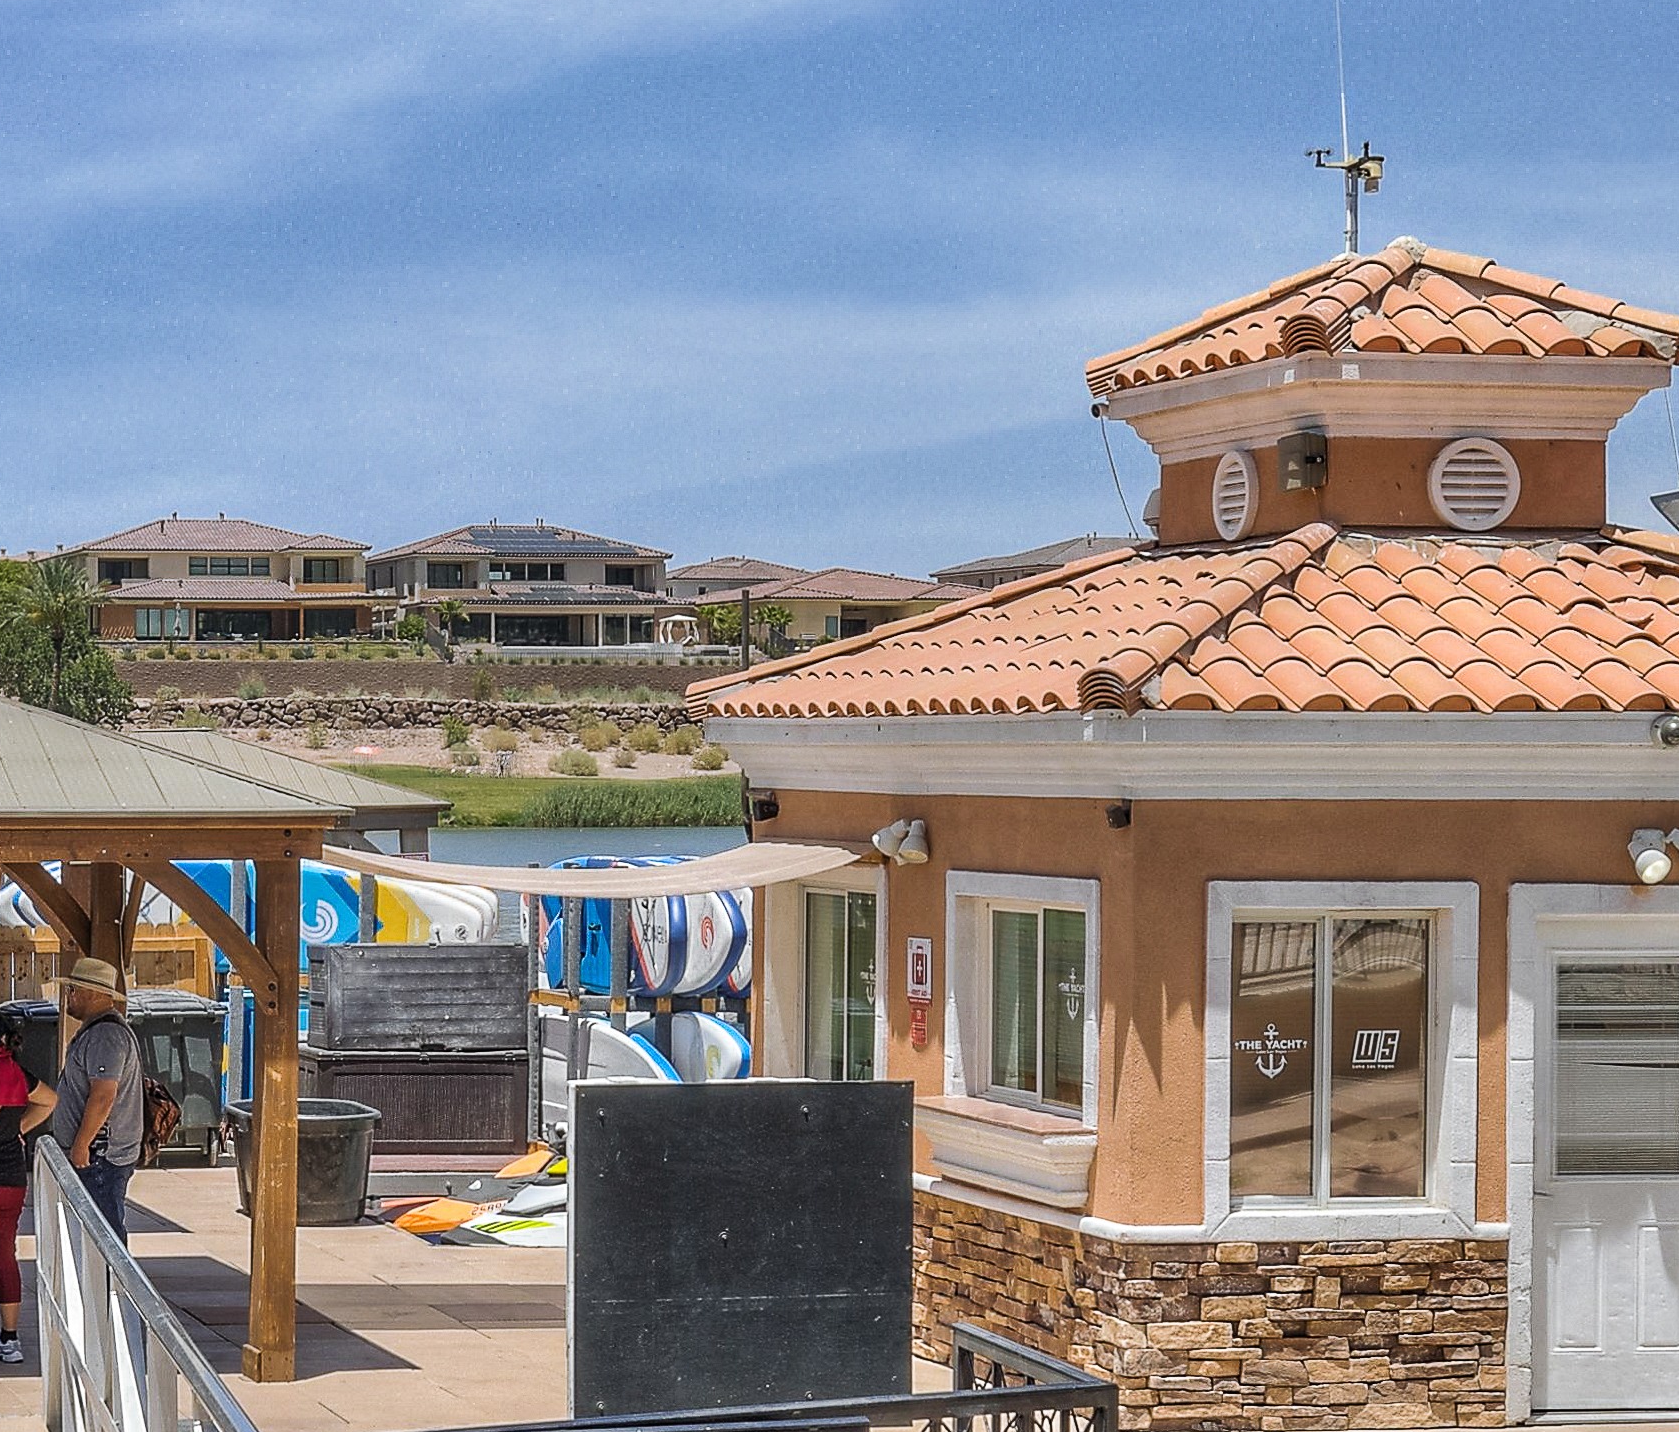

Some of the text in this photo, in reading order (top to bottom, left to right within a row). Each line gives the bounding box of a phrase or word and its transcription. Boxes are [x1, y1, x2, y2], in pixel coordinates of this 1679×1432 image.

[1239, 1039, 1302, 1050] THE YACHT
[1352, 1030, 1400, 1063] WS
